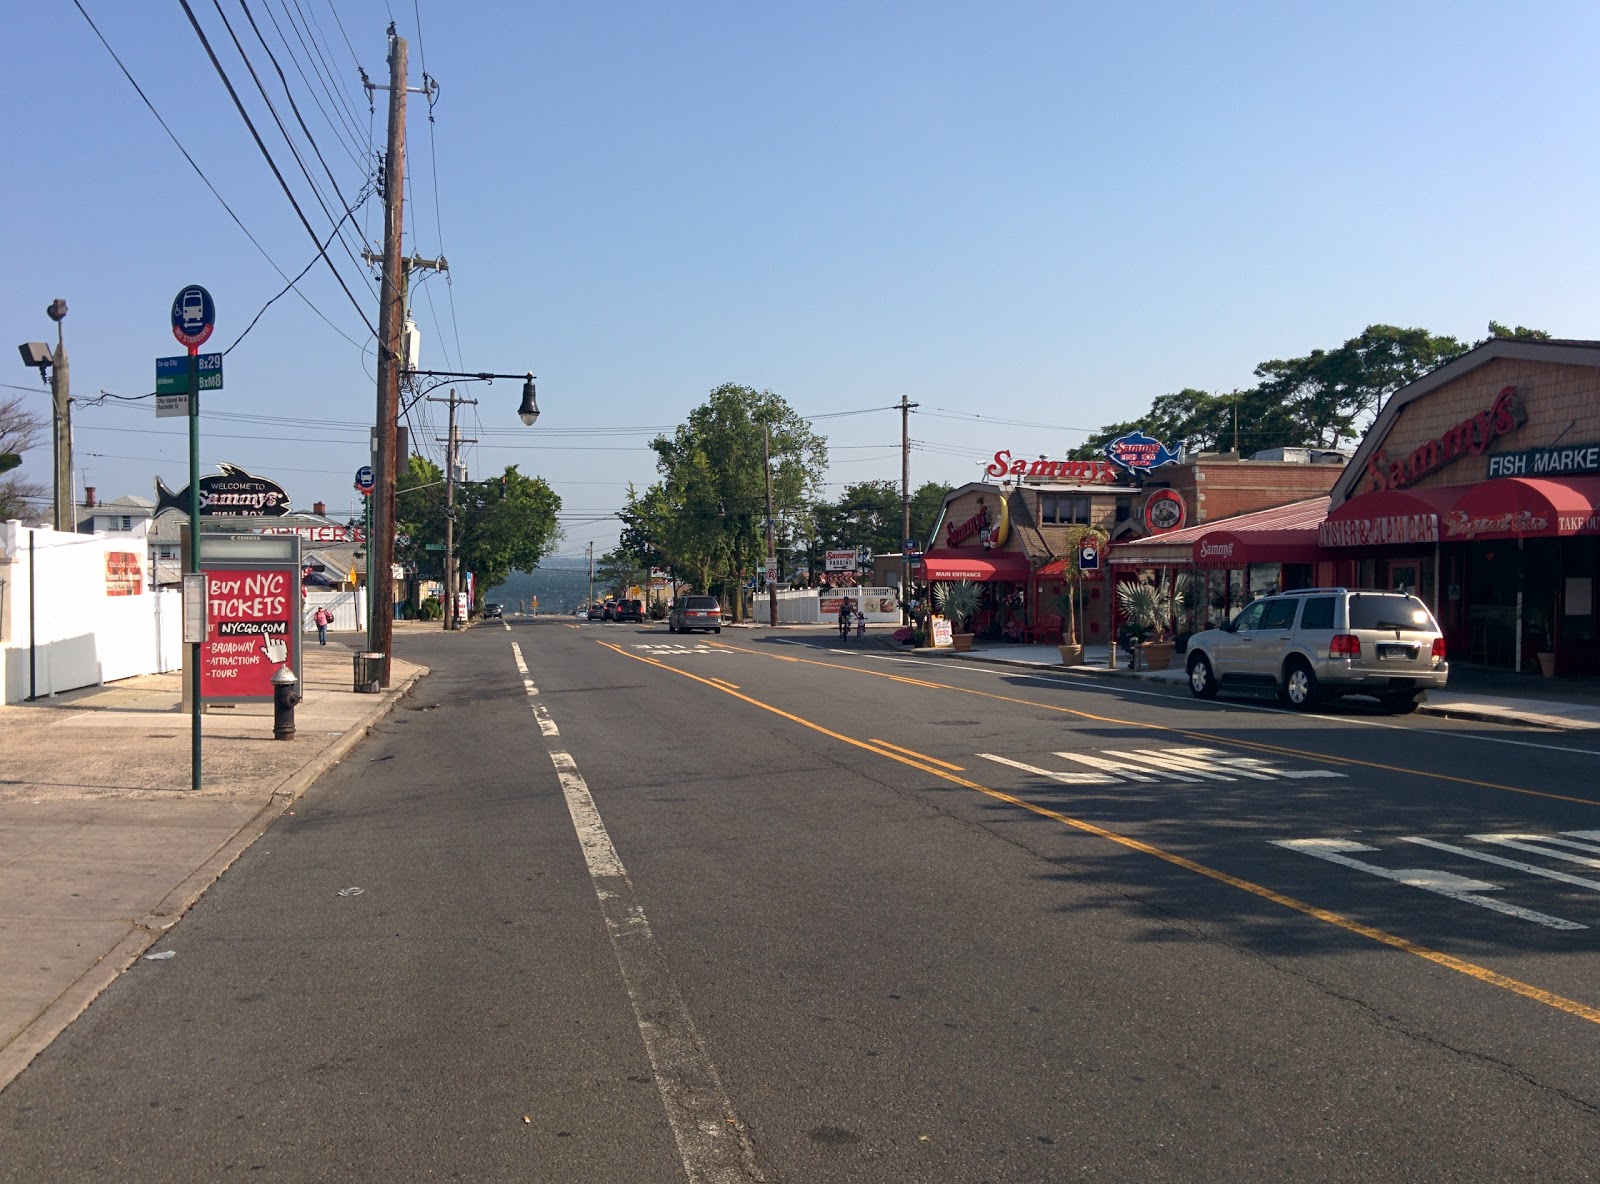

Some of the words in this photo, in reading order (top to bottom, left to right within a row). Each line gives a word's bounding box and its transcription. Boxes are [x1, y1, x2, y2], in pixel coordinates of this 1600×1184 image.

[175, 327, 184, 339] NO
[183, 326, 210, 344] STANDING
[199, 354, 221, 370] Bx29
[199, 373, 222, 389] BxM8
[1489, 455, 1526, 477] FISH
[1318, 520, 1357, 548] OYSTER
[1357, 519, 1370, 546] &
[1370, 516, 1406, 545] CLAM
[1408, 514, 1439, 543] BAR
[1443, 510, 1512, 539] Tropical
[1511, 510, 1549, 532] Bar
[1558, 517, 1585, 530] TAKE
[209, 580, 241, 595] BUY
[245, 573, 284, 597] NYC
[209, 596, 286, 617] TICKETS
[221, 622, 286, 634] NYCGO.COM
[974, 748, 1350, 784] LANE
[1265, 829, 1600, 931] FI
